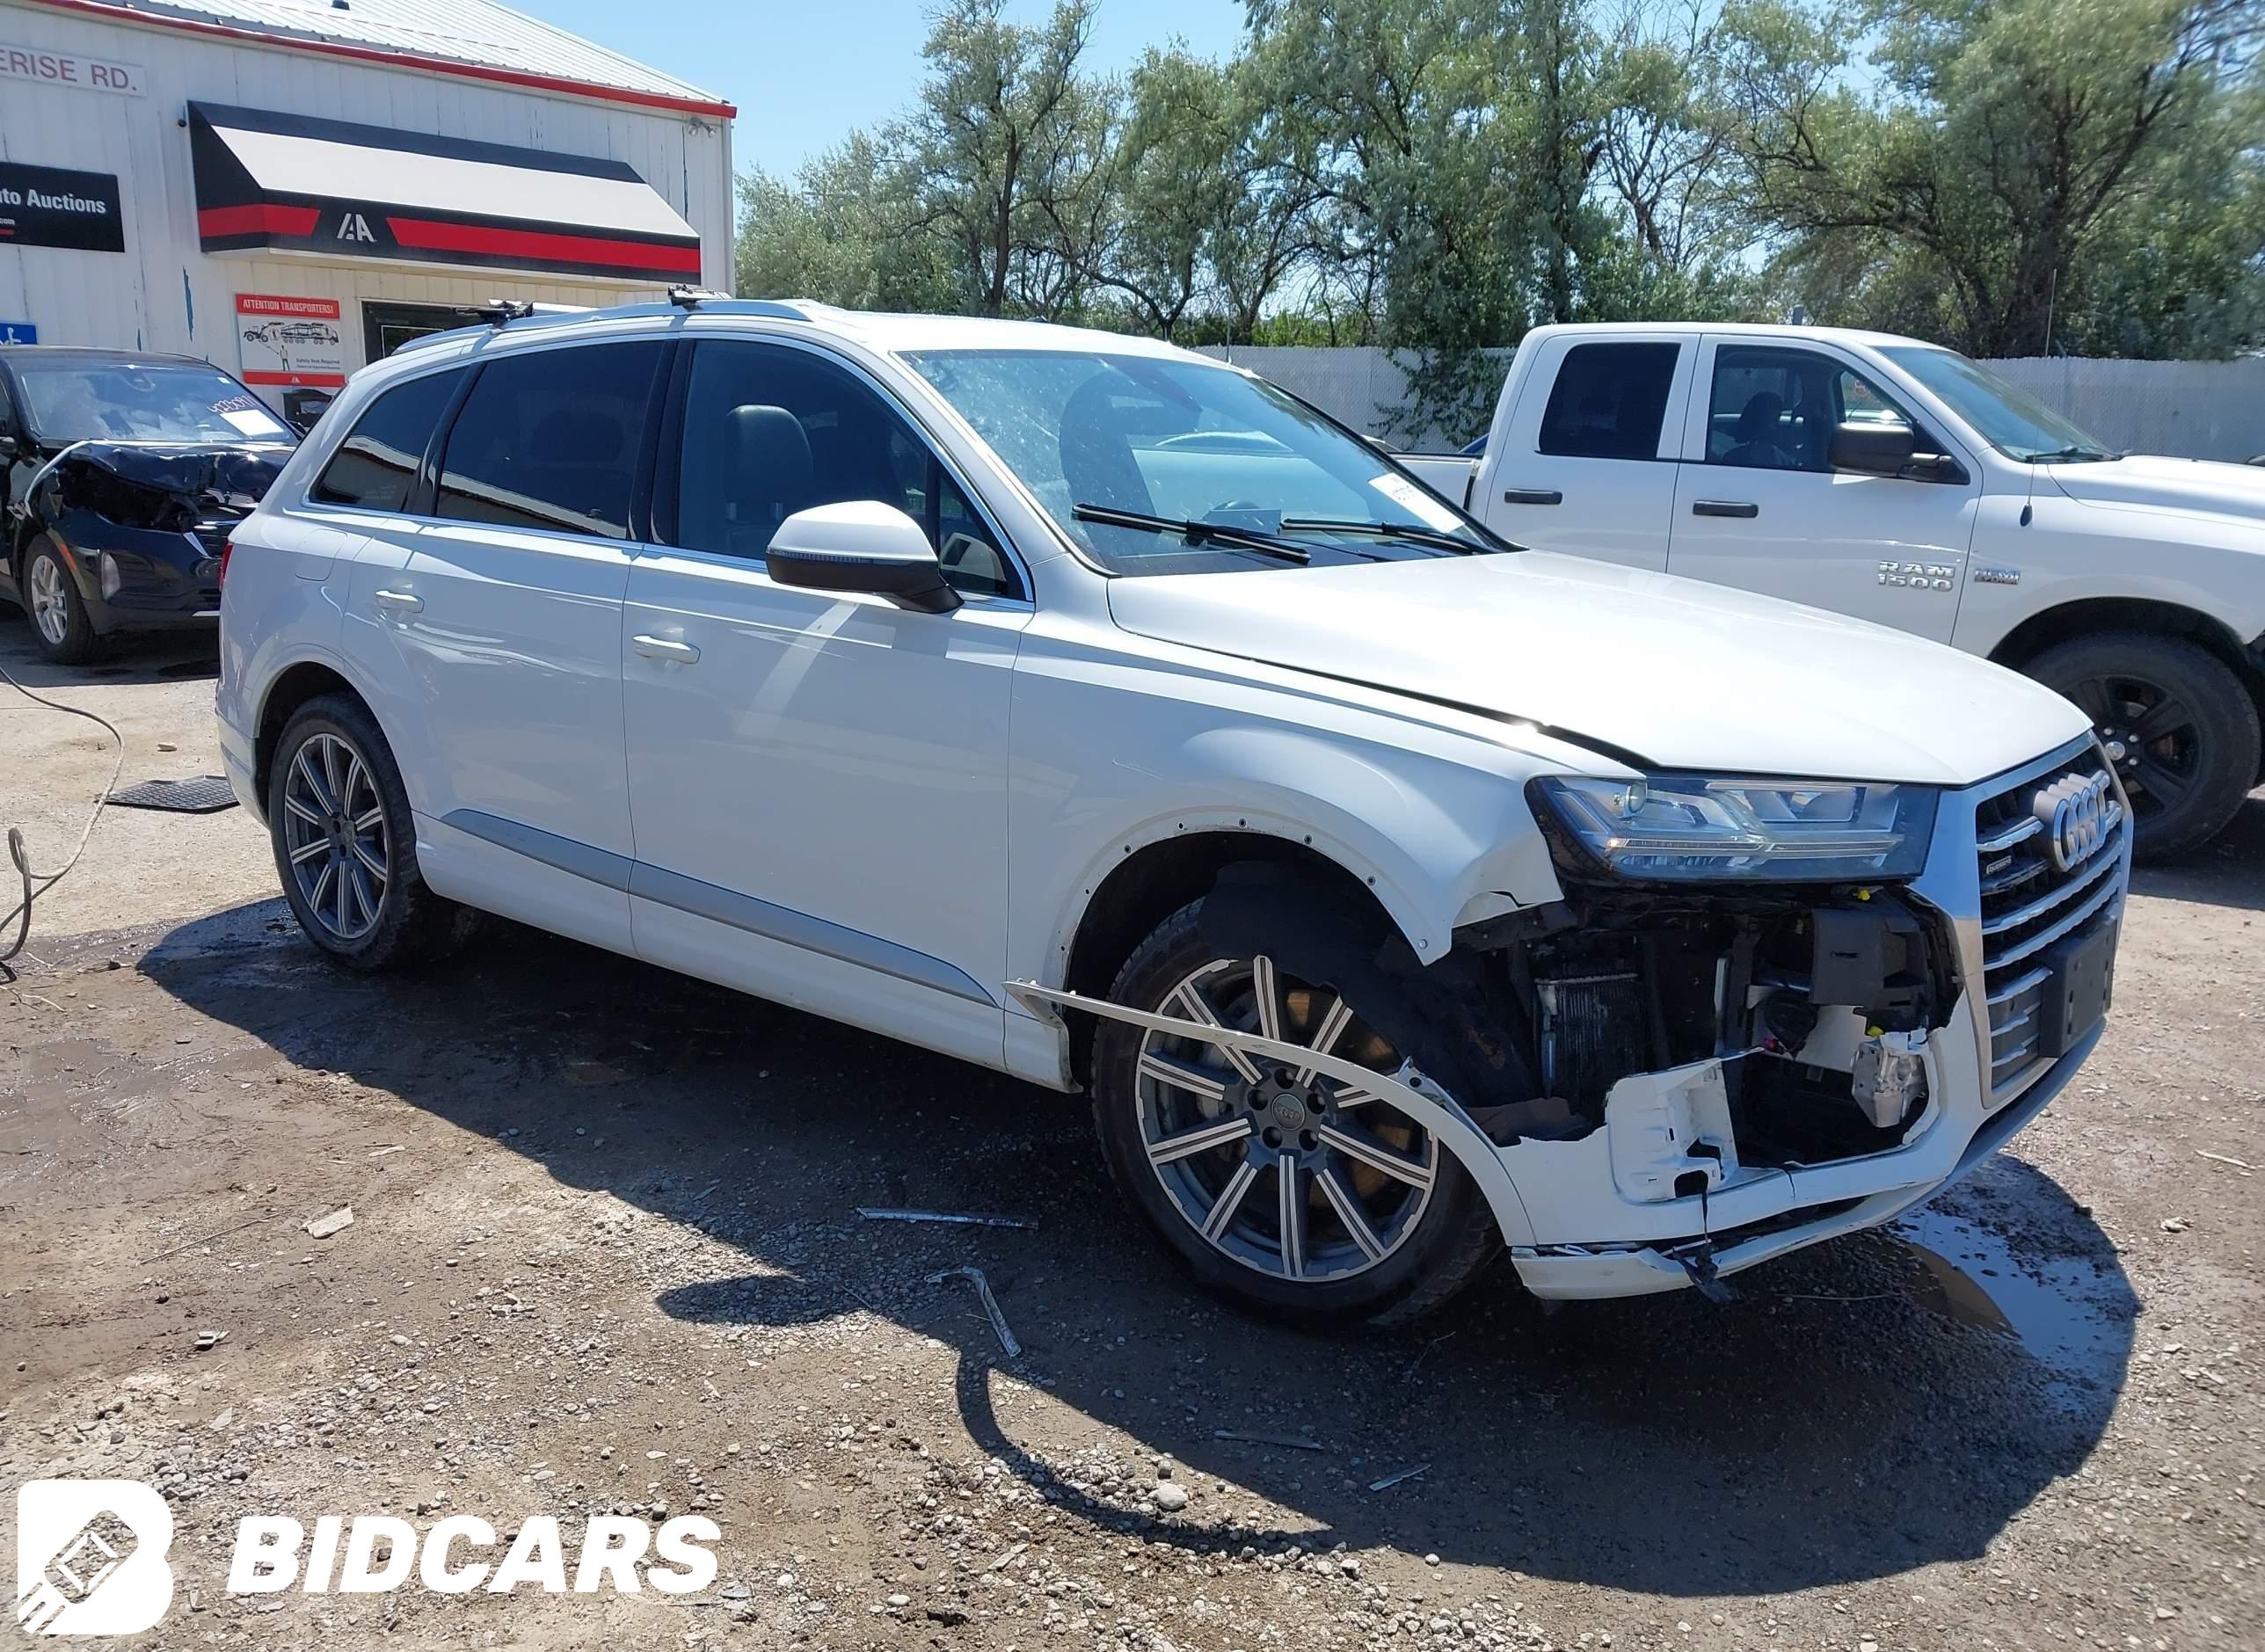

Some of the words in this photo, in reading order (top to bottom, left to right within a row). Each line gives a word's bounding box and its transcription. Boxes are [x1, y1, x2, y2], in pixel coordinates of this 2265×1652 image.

[91, 63, 137, 91] RD.
[26, 189, 106, 214] Auctions
[243, 299, 280, 310] ATTENTION
[280, 301, 334, 314] TRANSPORTERS!
[1878, 560, 1955, 578] RAM
[1877, 573, 1954, 592] 1500
